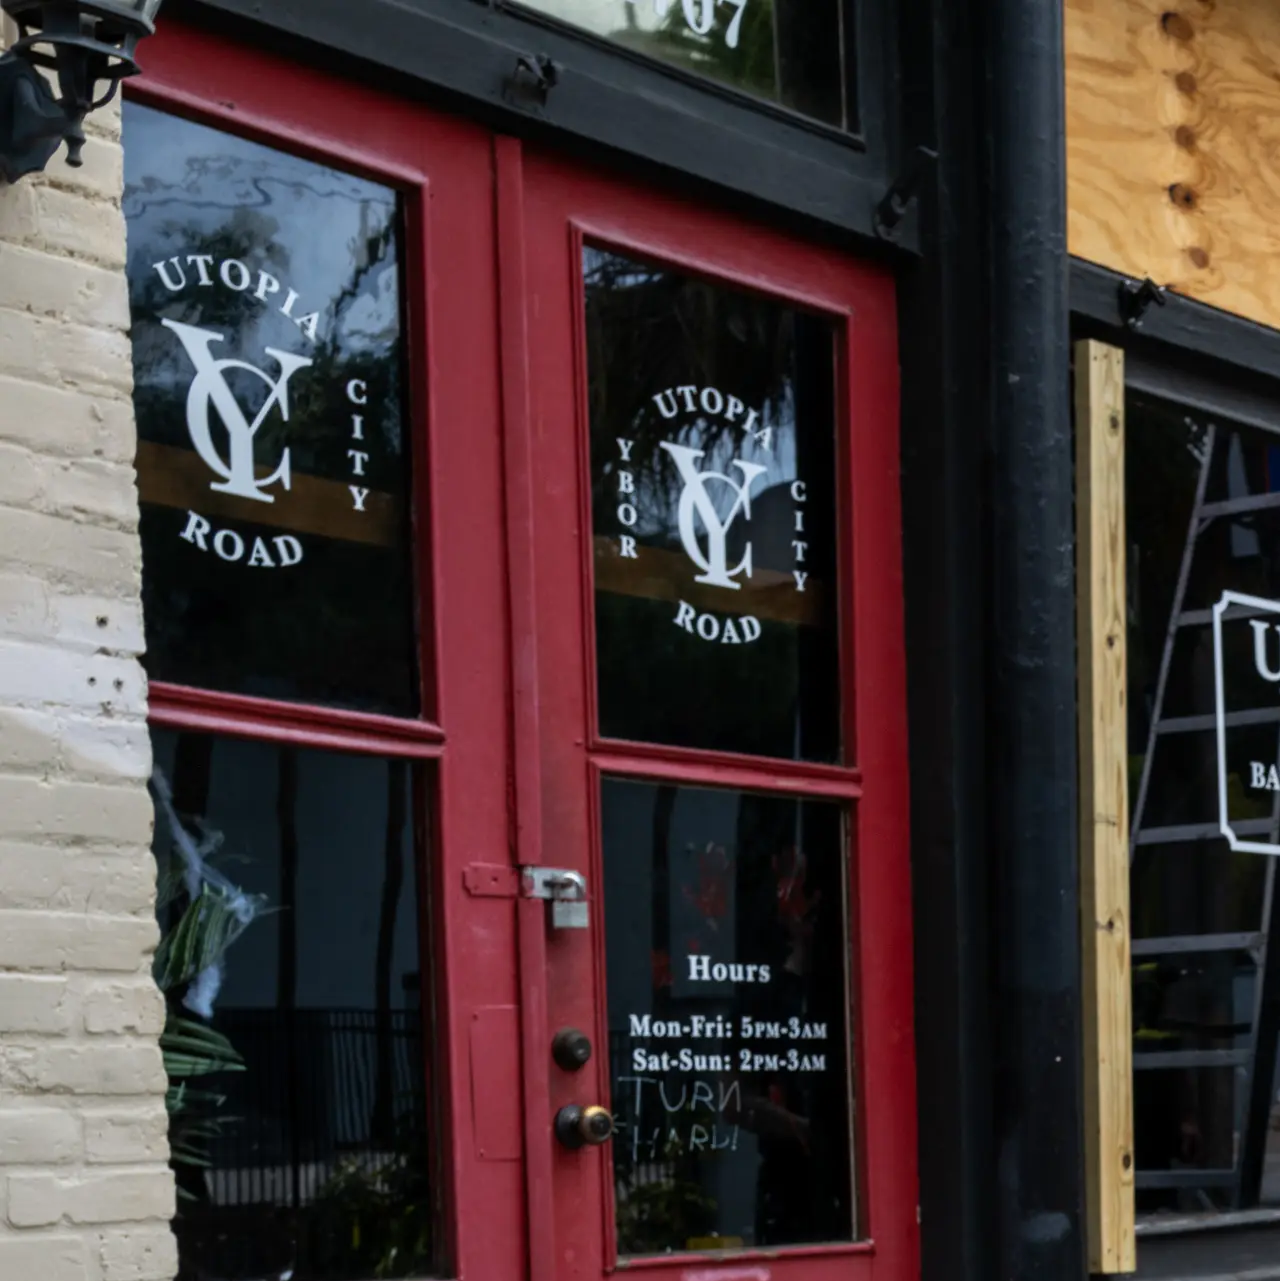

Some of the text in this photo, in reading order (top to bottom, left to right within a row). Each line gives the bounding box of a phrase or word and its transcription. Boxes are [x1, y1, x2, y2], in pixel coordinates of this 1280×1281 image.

[153, 254, 320, 341] UTOPIA
[346, 379, 370, 511] CITY
[653, 384, 772, 451] UTOPIA
[616, 438, 639, 559] YBOR
[179, 510, 304, 567] ROAD
[791, 481, 809, 592] CITY
[673, 600, 762, 644] ROAD
[687, 955, 771, 983] Hours
[629, 1013, 828, 1039] Mon-Fri: 5PM-3AM
[633, 1048, 827, 1072] Sat-Sun: 2PM-3AM
[618, 1077, 741, 1117] TURN
